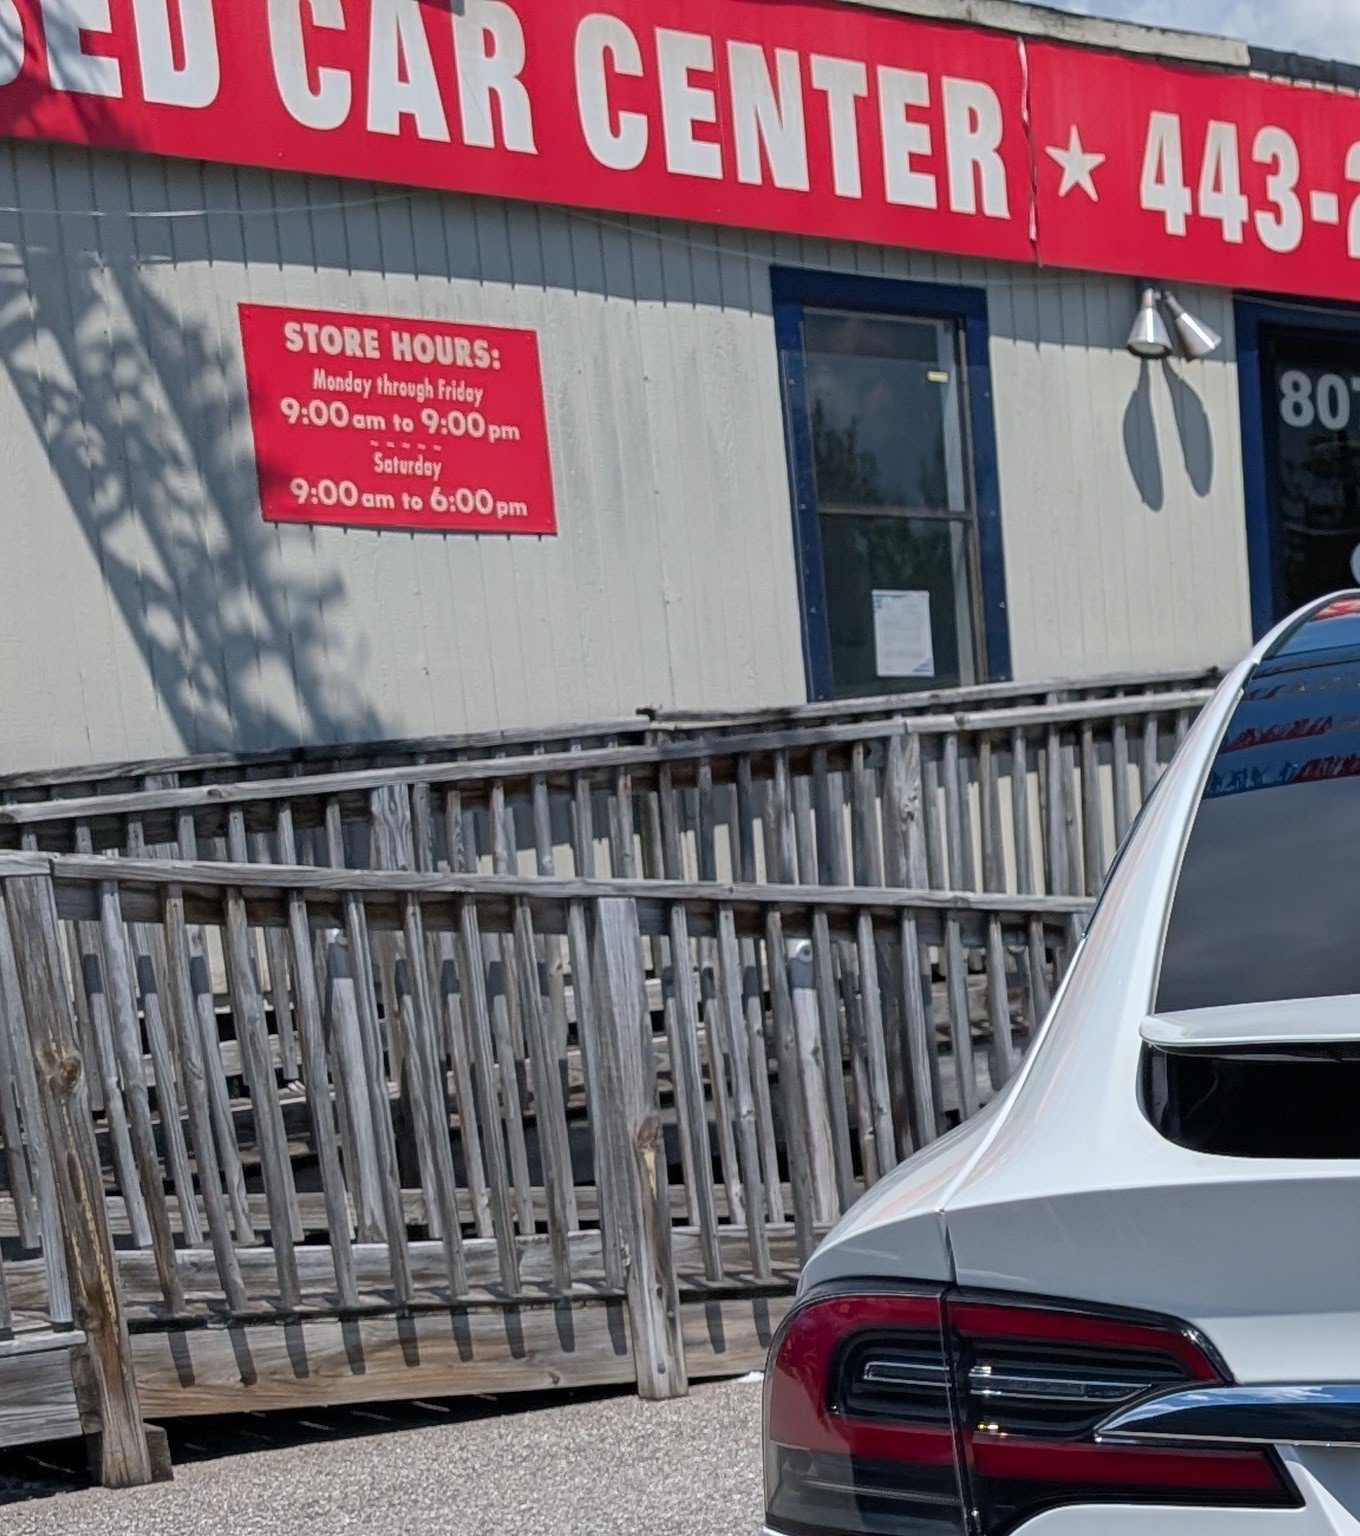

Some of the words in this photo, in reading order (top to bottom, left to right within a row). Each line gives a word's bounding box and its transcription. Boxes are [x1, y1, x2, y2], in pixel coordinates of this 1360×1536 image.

[0, 0, 220, 108] ED
[265, 0, 538, 155] CAR
[573, 13, 1011, 219] CENTER
[284, 322, 380, 359] STORE
[391, 330, 501, 370] HOURS:
[313, 368, 372, 398] Monday
[377, 373, 434, 403] through
[437, 379, 484, 408] Friday
[393, 413, 414, 432] to
[374, 451, 442, 481] Saturday
[402, 491, 423, 511] to
